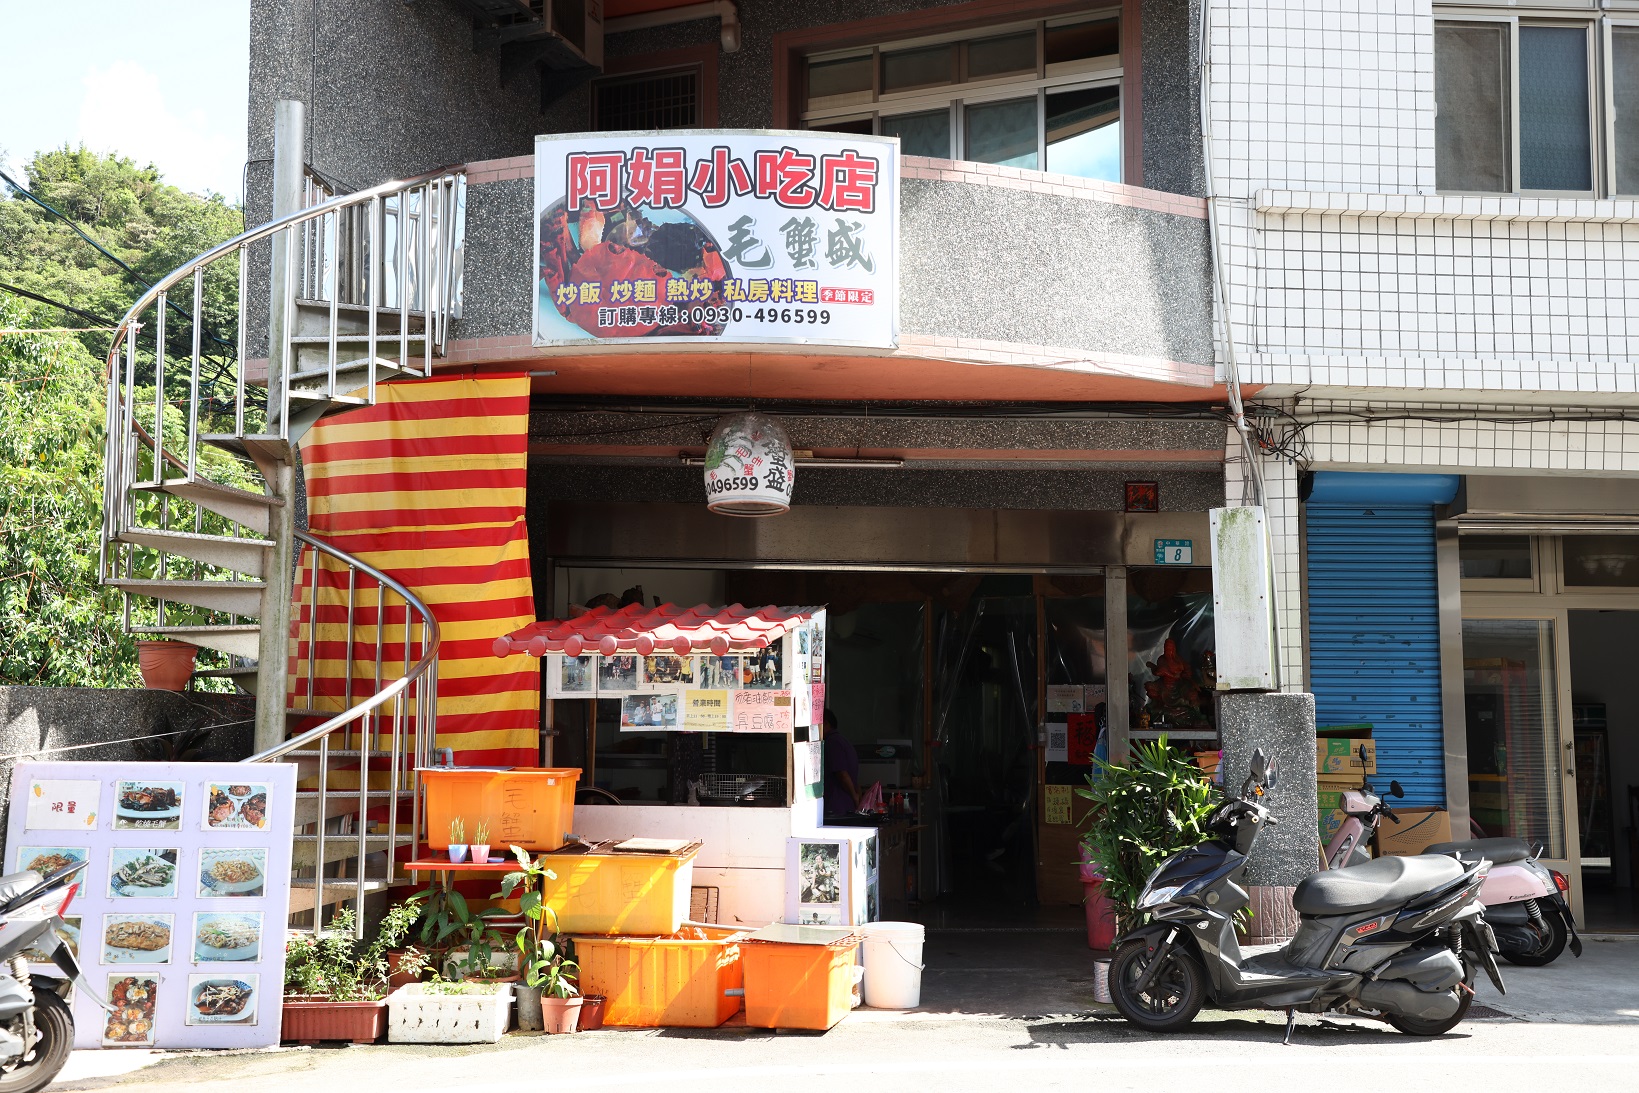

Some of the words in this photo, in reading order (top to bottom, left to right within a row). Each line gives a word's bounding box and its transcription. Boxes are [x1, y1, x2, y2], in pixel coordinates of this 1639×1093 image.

[566, 146, 879, 213] 阿娟小吃店
[723, 214, 875, 274] 毛蟹盛
[556, 282, 601, 305] 炒飯
[611, 280, 657, 303] 炒麵
[666, 279, 713, 302] 熱炒
[723, 279, 819, 304] 私房料理
[822, 289, 873, 303] 季節限定
[705, 476, 759, 496] 0496599
[1174, 548, 1182, 562] 8
[692, 699, 721, 707] 營業時間
[735, 711, 774, 730] 臭豆腐
[51, 800, 77, 814] 限量
